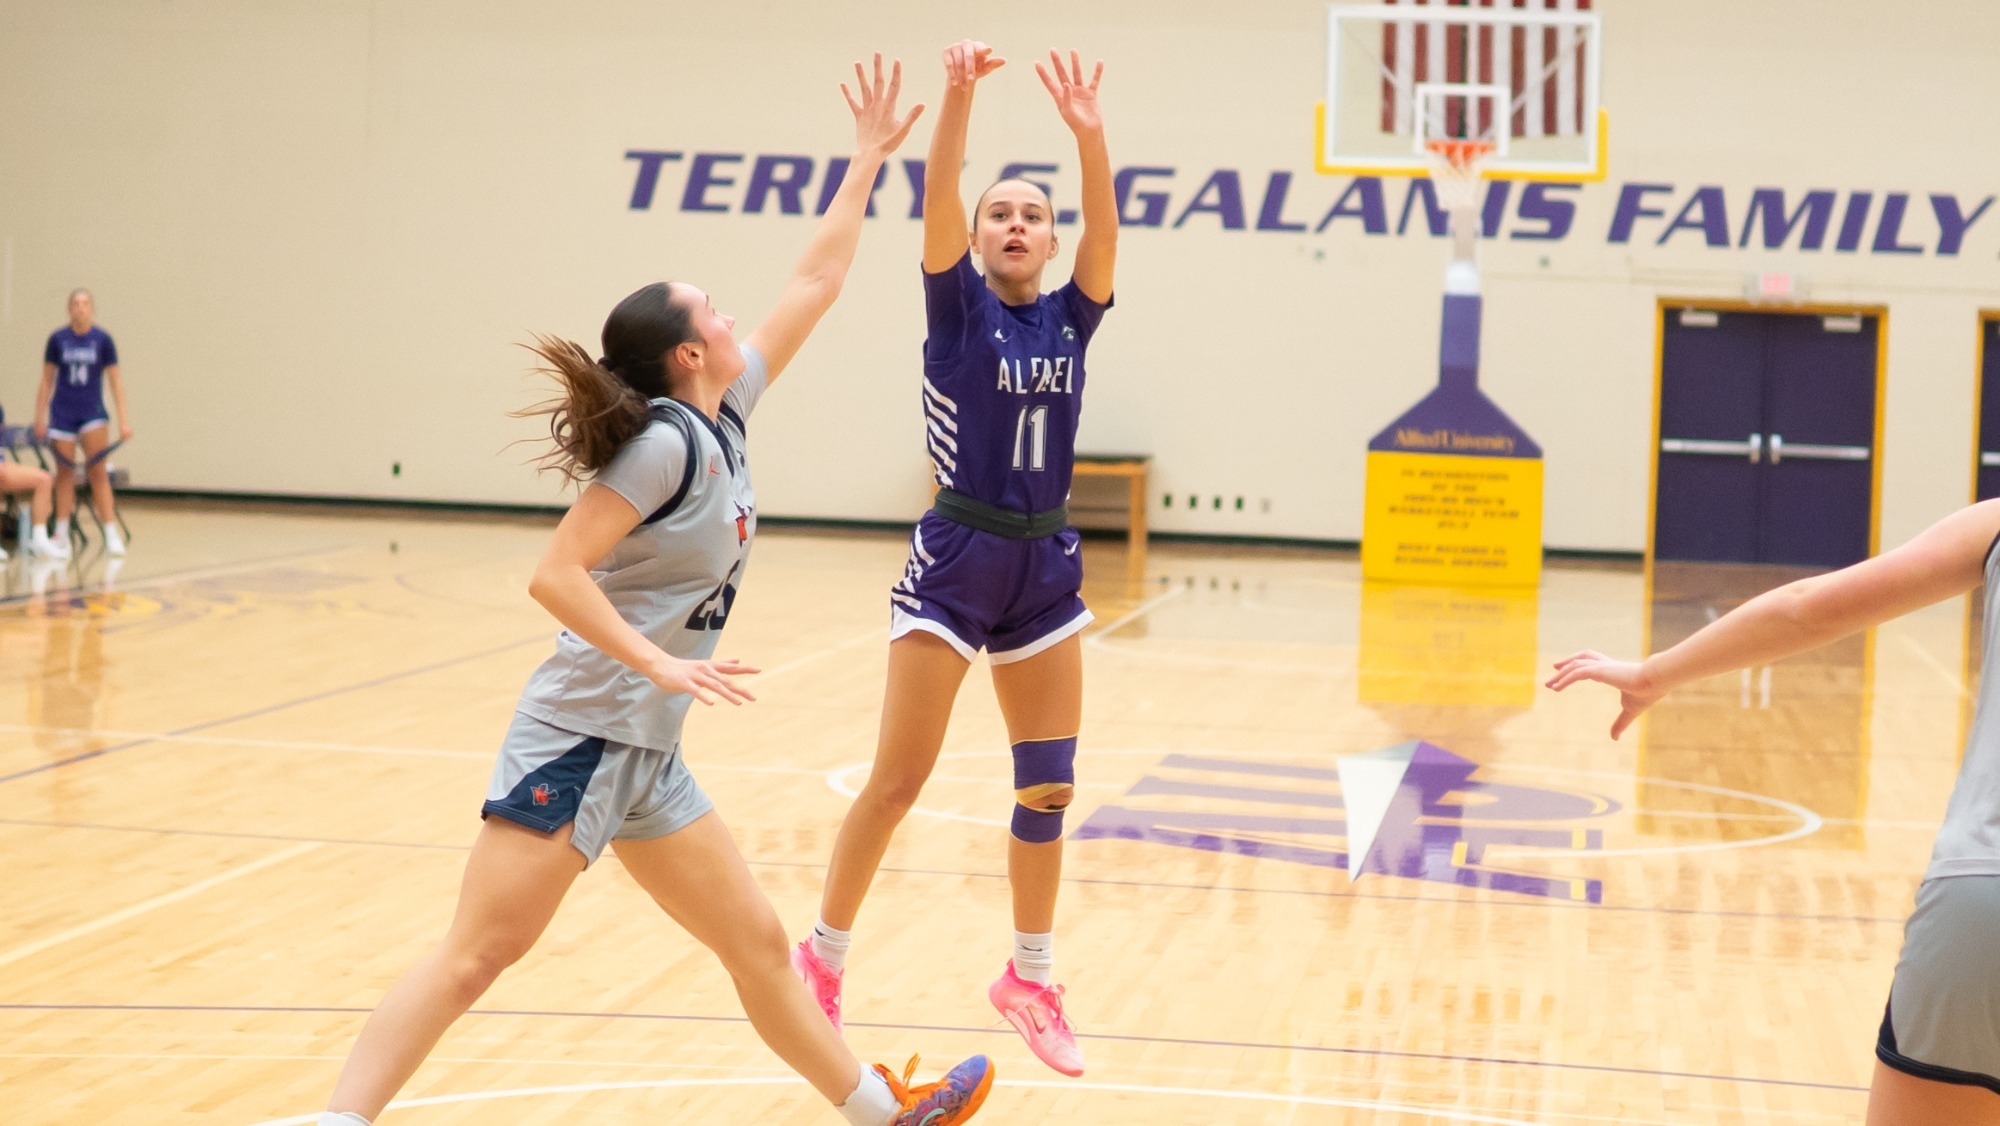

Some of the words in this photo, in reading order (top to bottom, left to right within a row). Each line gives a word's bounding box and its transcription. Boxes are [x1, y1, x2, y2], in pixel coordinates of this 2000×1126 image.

[1114, 166, 1580, 241] GALANIS
[1607, 183, 1996, 256] FAMILY
[1012, 405, 1048, 471] 11
